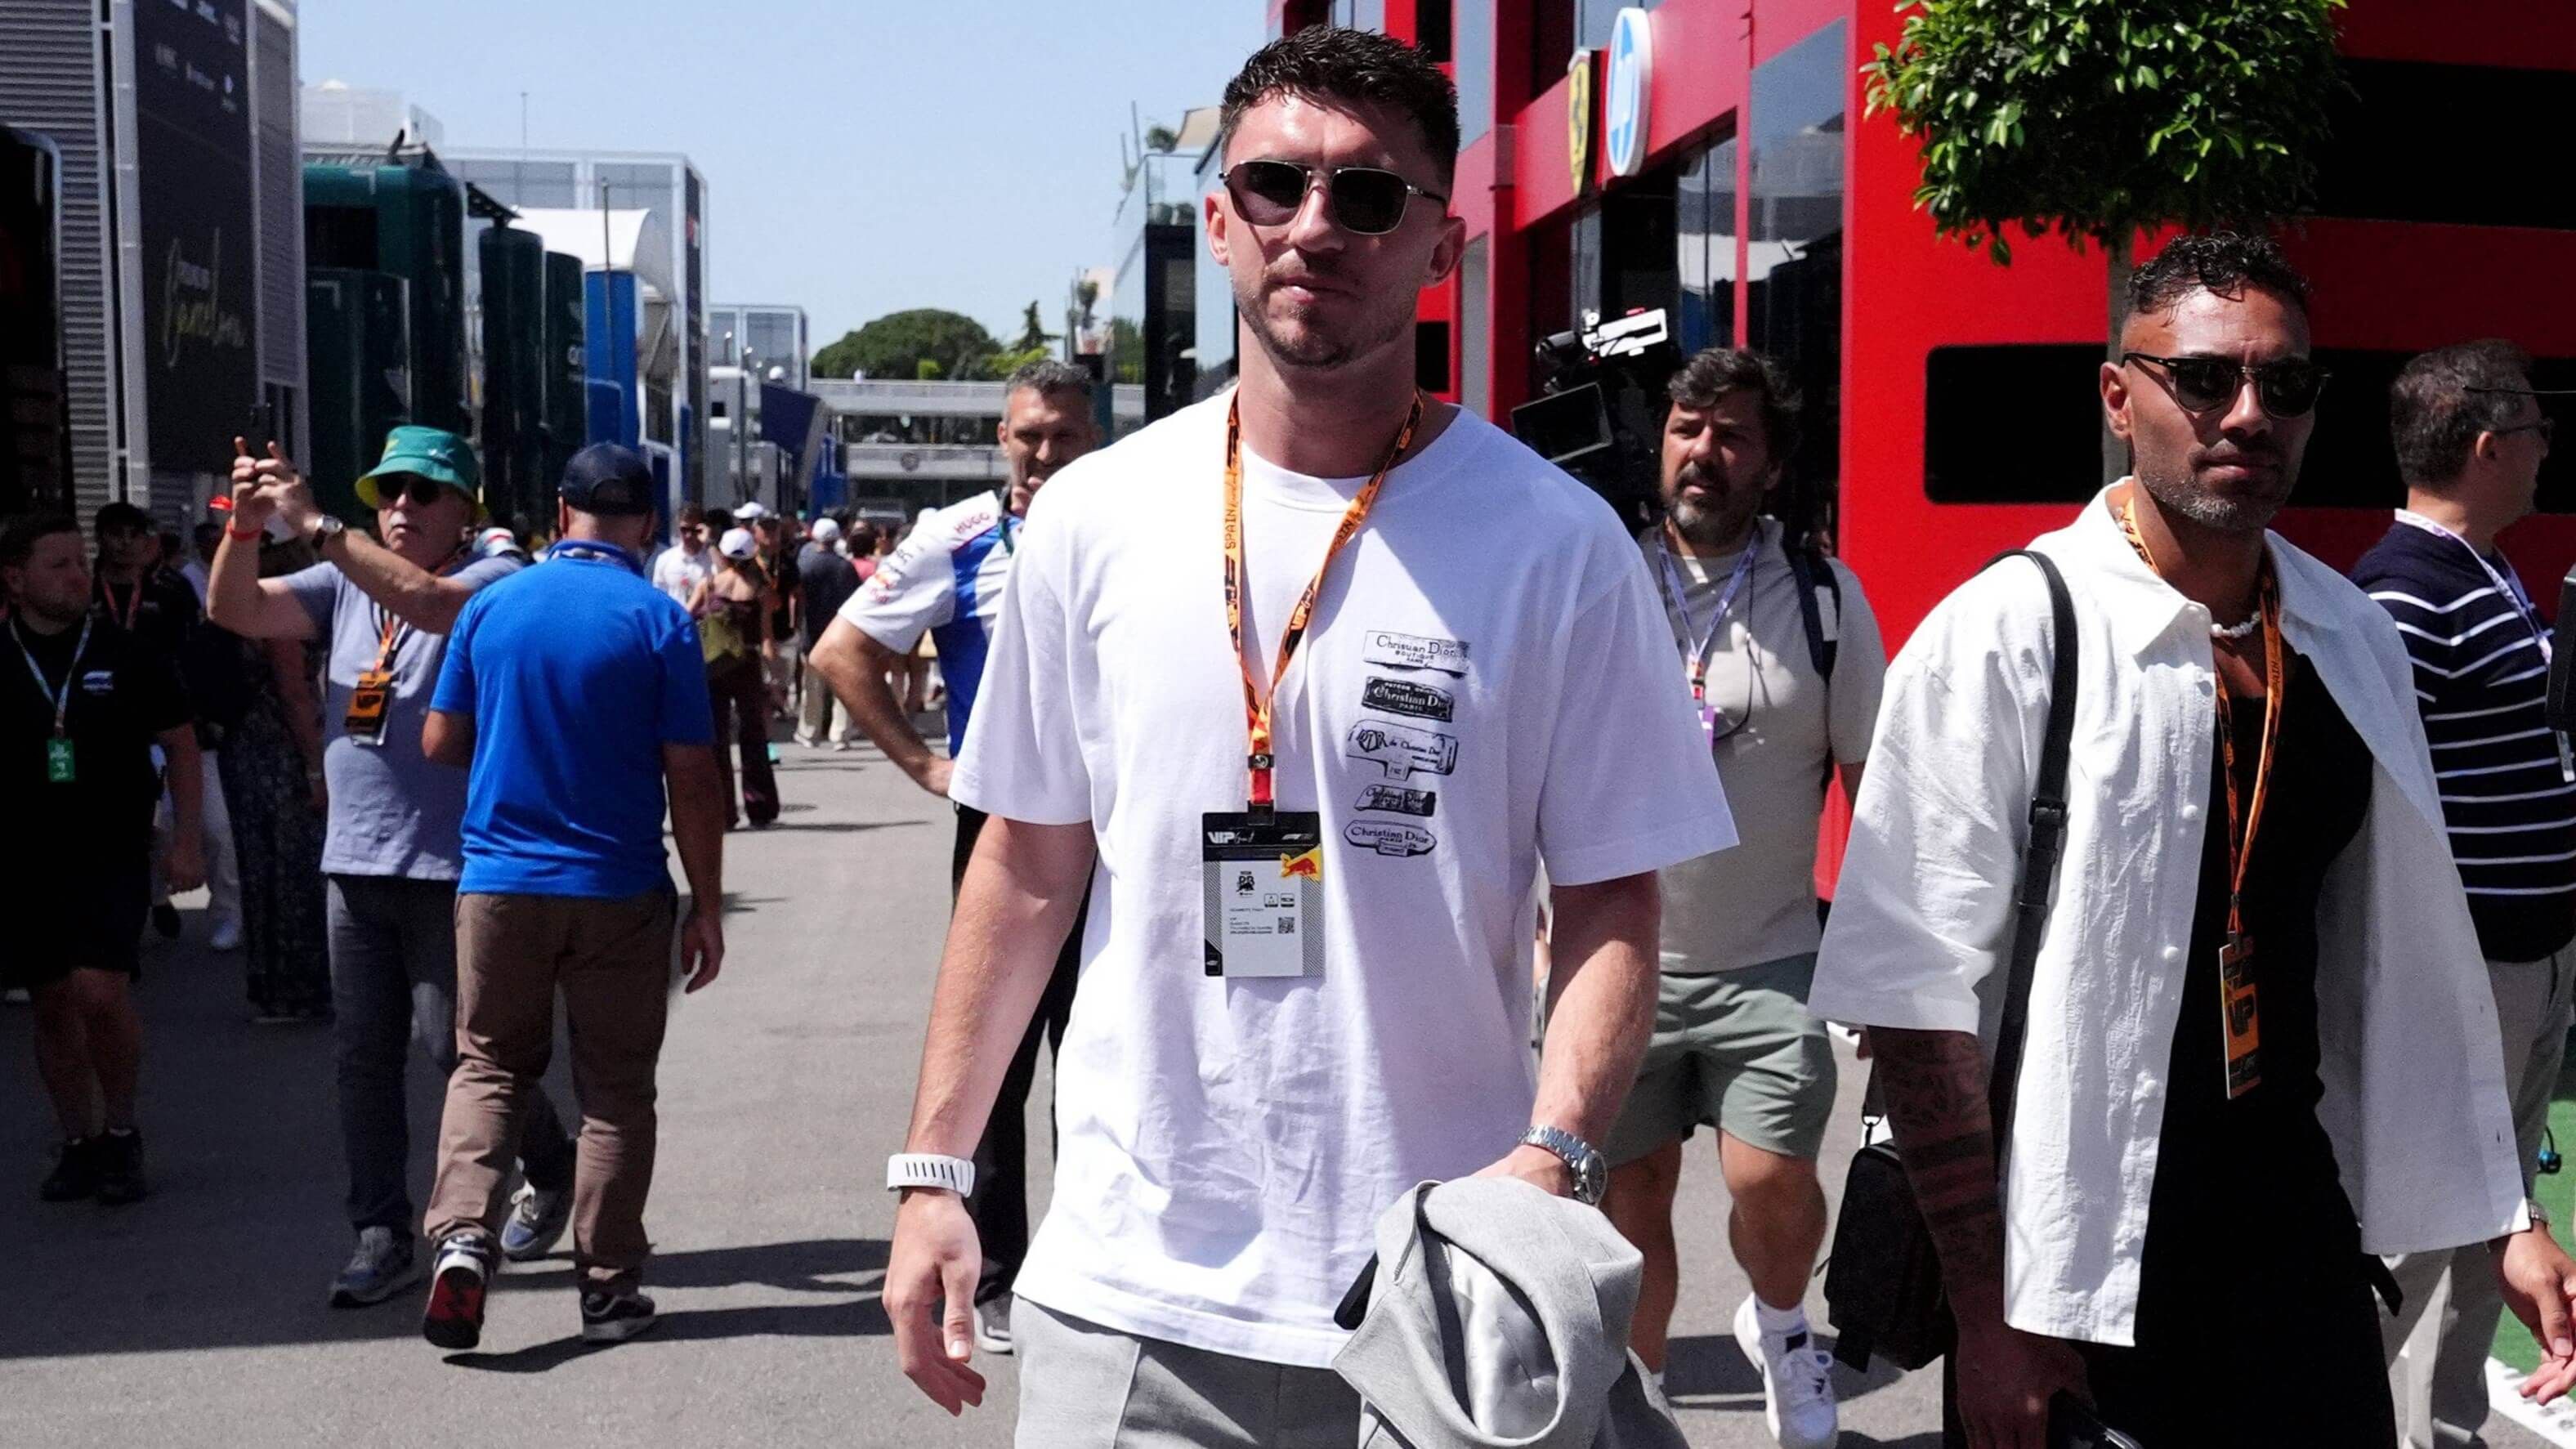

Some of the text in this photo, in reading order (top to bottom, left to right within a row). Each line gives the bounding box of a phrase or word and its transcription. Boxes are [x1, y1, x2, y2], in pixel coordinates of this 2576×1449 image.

[953, 512, 990, 534] HUGO
[1225, 508, 1237, 549] SPAIN
[1376, 634, 1456, 656] Christian Dior
[1374, 684, 1426, 706] Christian
[1207, 831, 1235, 844] VIP
[1351, 826, 1429, 843] Christian Dior
